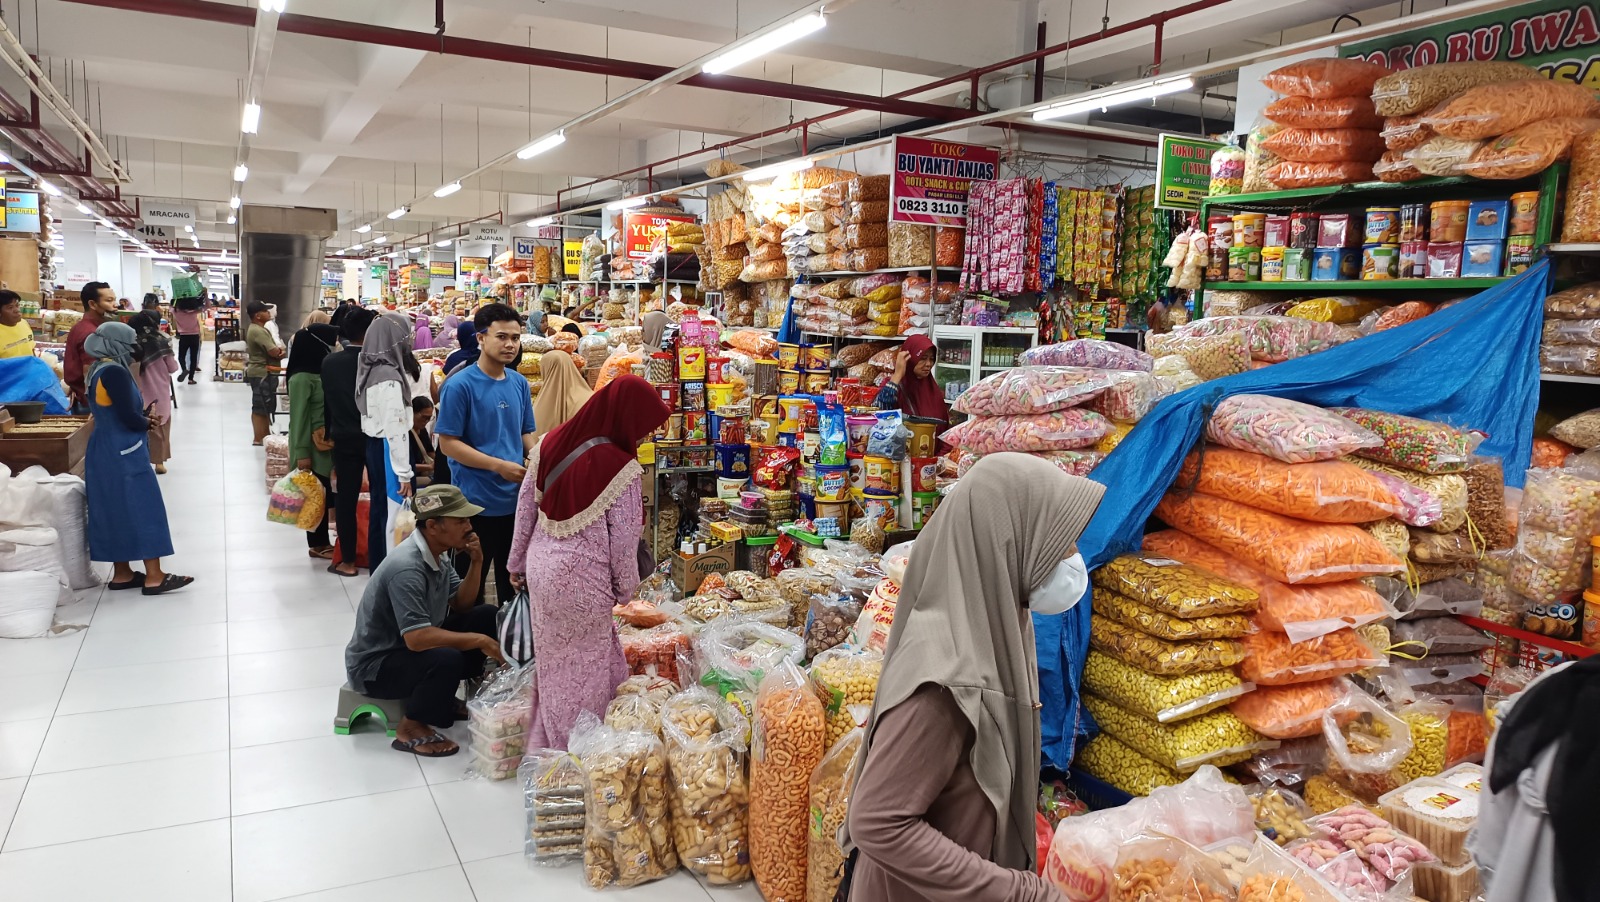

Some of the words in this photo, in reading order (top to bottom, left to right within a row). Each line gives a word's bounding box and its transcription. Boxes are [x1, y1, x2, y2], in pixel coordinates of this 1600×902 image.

[1446, 25, 1504, 64] BU
[1509, 6, 1600, 58] IWA
[931, 142, 966, 157] TOKO
[1170, 144, 1194, 158] TOKO
[898, 154, 917, 173] BU
[919, 156, 955, 177] YANTI
[956, 160, 994, 180] ANJAS
[925, 177, 948, 190] SNACK
[1166, 190, 1184, 198] SEDIA
[900, 199, 928, 212] 0823
[931, 202, 959, 215] 3110
[149, 210, 190, 219] MRACANG
[566, 249, 575, 258] BU
[694, 560, 727, 573] Marjan
